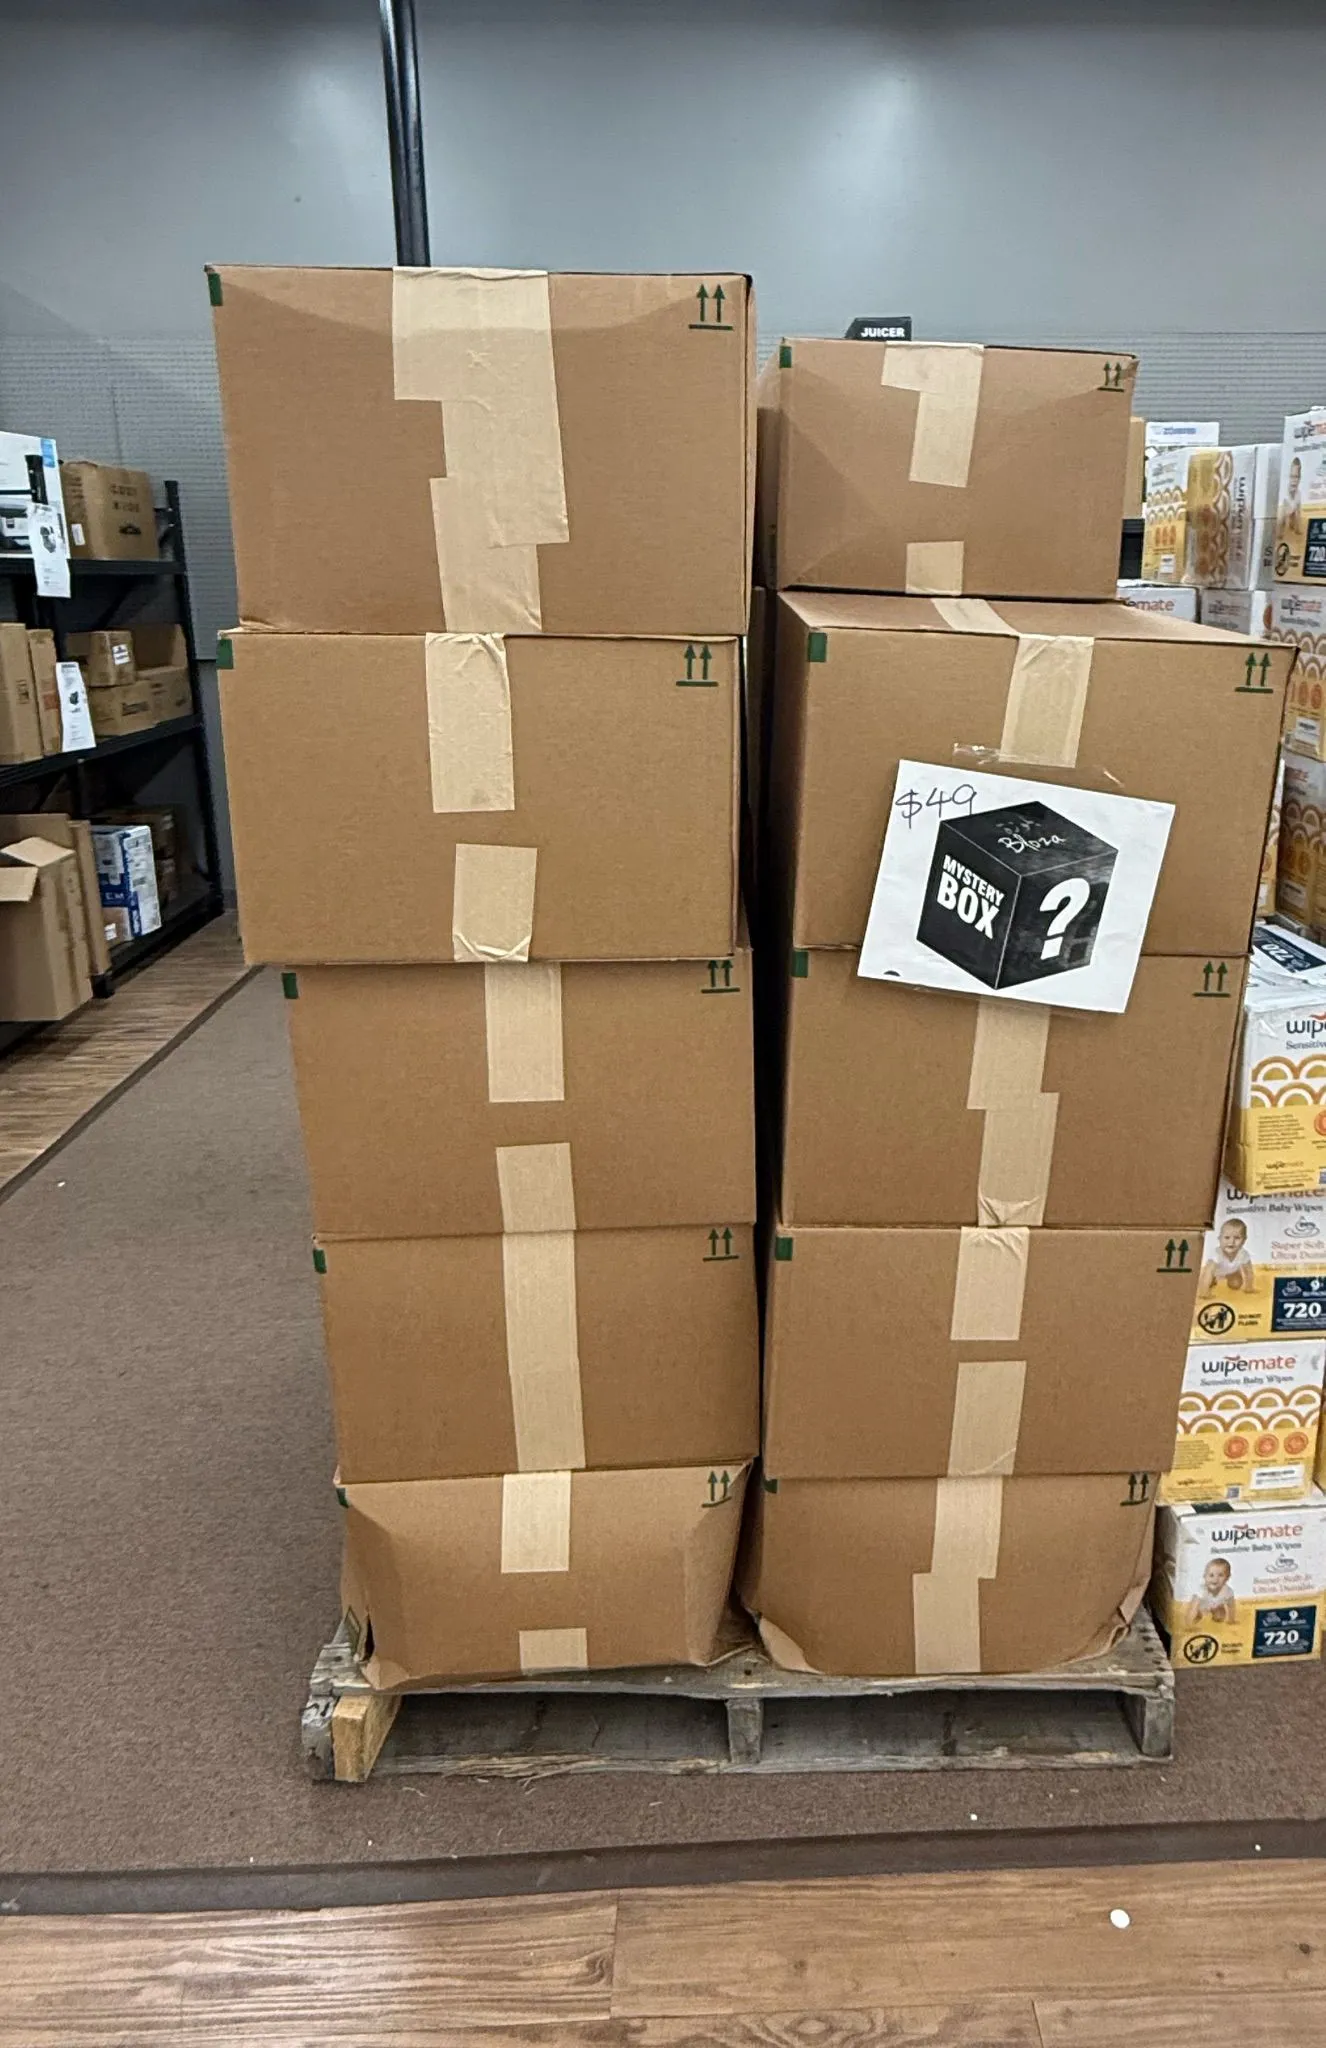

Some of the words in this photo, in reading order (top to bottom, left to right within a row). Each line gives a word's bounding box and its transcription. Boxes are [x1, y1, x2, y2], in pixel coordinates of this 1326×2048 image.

[861, 327, 905, 337] JUICER
[895, 784, 977, 829] $49
[944, 854, 1005, 908] MYSTERY
[937, 872, 999, 940] BOX
[1283, 1302, 1322, 1318] 720
[1202, 1355, 1297, 1377] wipemate
[1211, 1524, 1303, 1545] wipemate
[1264, 1630, 1299, 1646] 720
